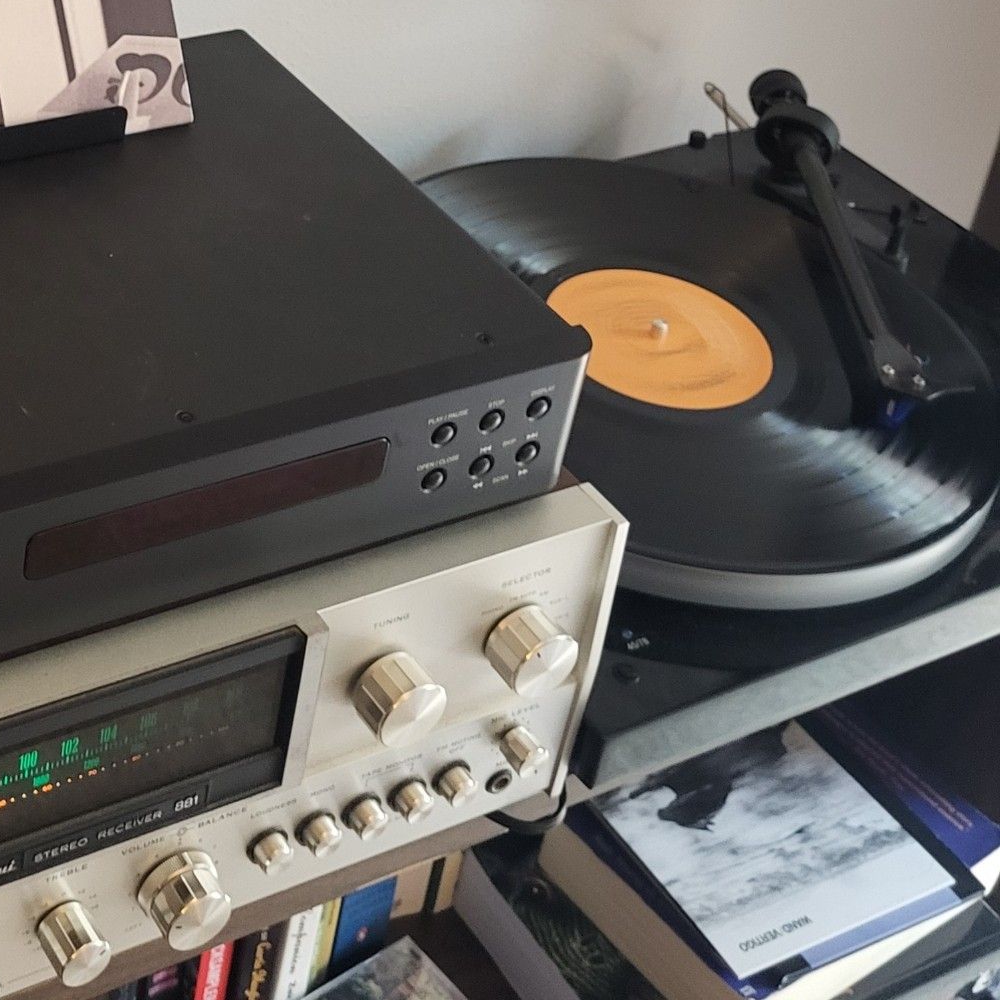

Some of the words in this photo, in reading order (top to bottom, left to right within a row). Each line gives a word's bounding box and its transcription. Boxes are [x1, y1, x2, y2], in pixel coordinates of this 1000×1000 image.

[373, 612, 411, 629] TUNING
[18, 750, 38, 771] 100
[60, 736, 81, 757] 102
[100, 723, 118, 744] 104
[197, 807, 248, 829] BALANCE
[33, 836, 90, 864] STEREO
[97, 809, 163, 840] RECEIVER
[120, 835, 166, 857] VOLUME
[44, 861, 89, 883] TREBLE
[738, 926, 782, 953] VERTIGO
